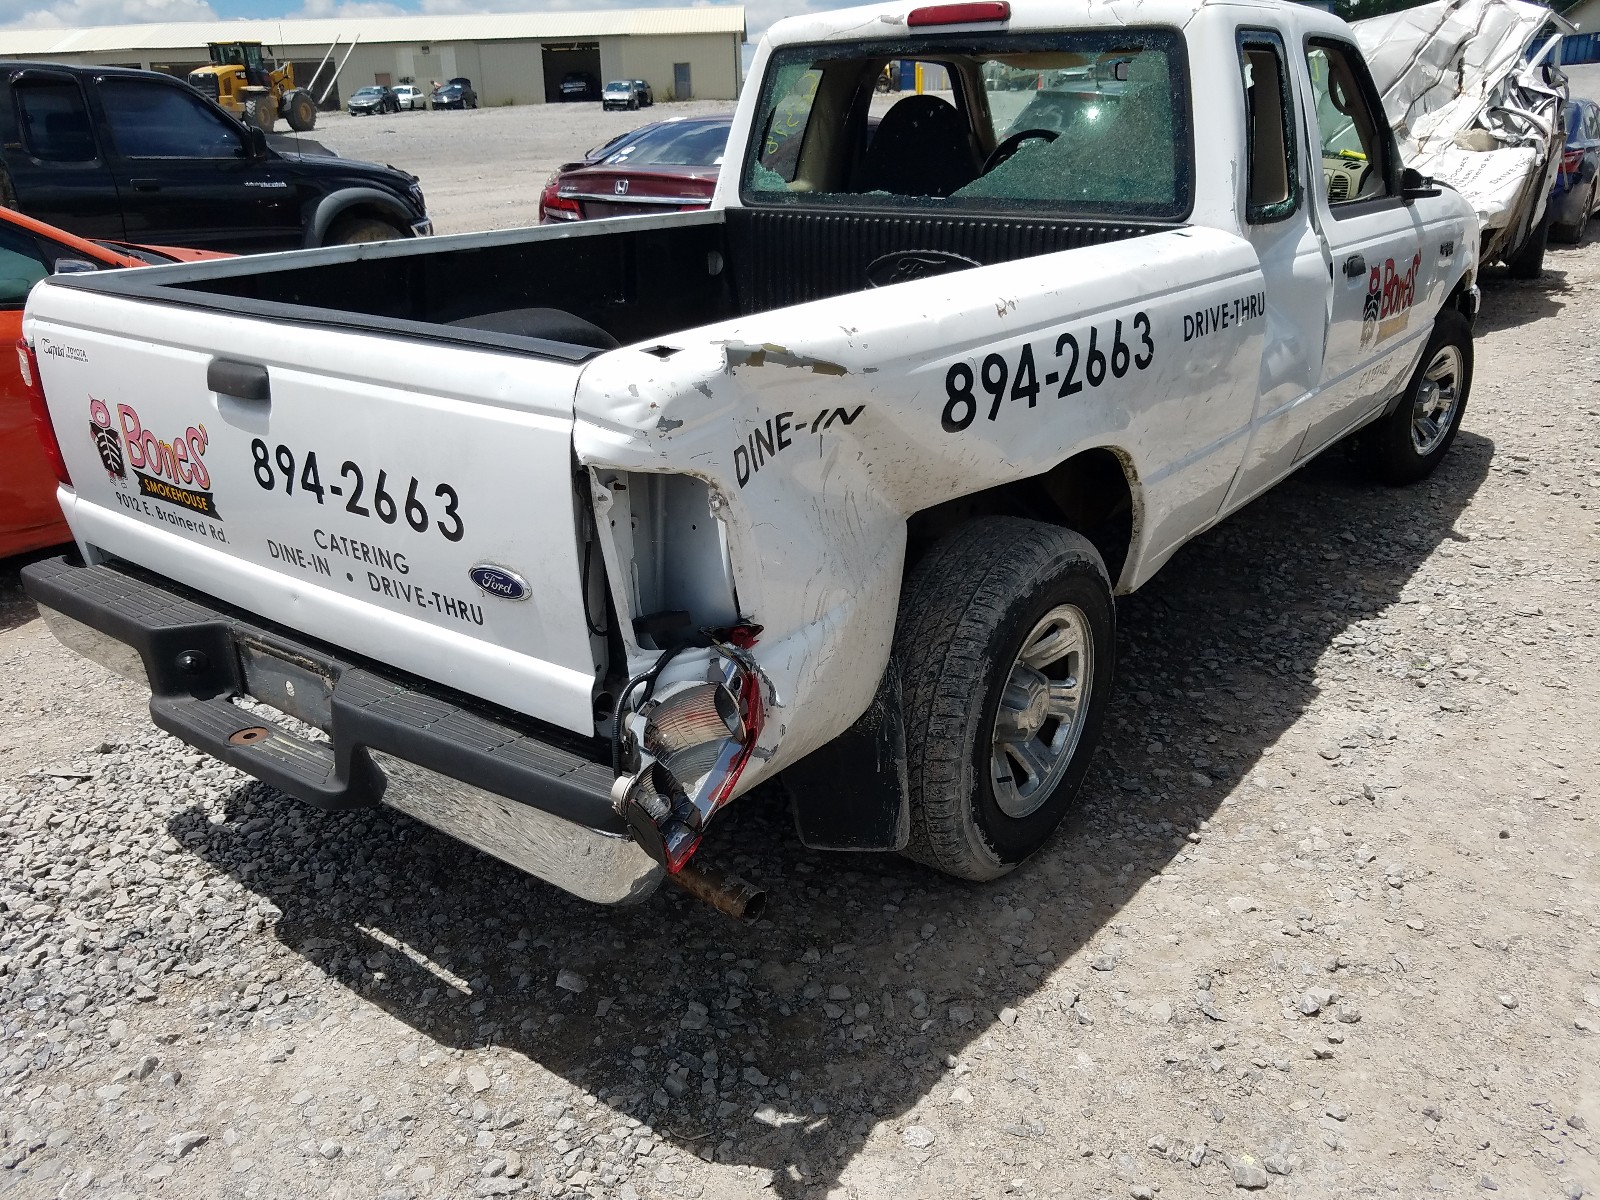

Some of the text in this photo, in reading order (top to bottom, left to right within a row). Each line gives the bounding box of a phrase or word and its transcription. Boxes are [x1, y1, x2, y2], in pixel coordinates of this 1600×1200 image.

[1182, 291, 1267, 342] DRIVE-THRU
[940, 311, 1155, 434] 894-2663
[732, 404, 867, 490] DINE-IN
[144, 478, 209, 511] SMOKEHOUSE
[251, 438, 465, 542] 894-2663
[115, 491, 231, 545] 9012 E. Brainerd Rd.
[313, 528, 410, 575] CATERING
[267, 538, 484, 626] DINE-IN DRIVE-THRU
[480, 571, 513, 596] Ford
